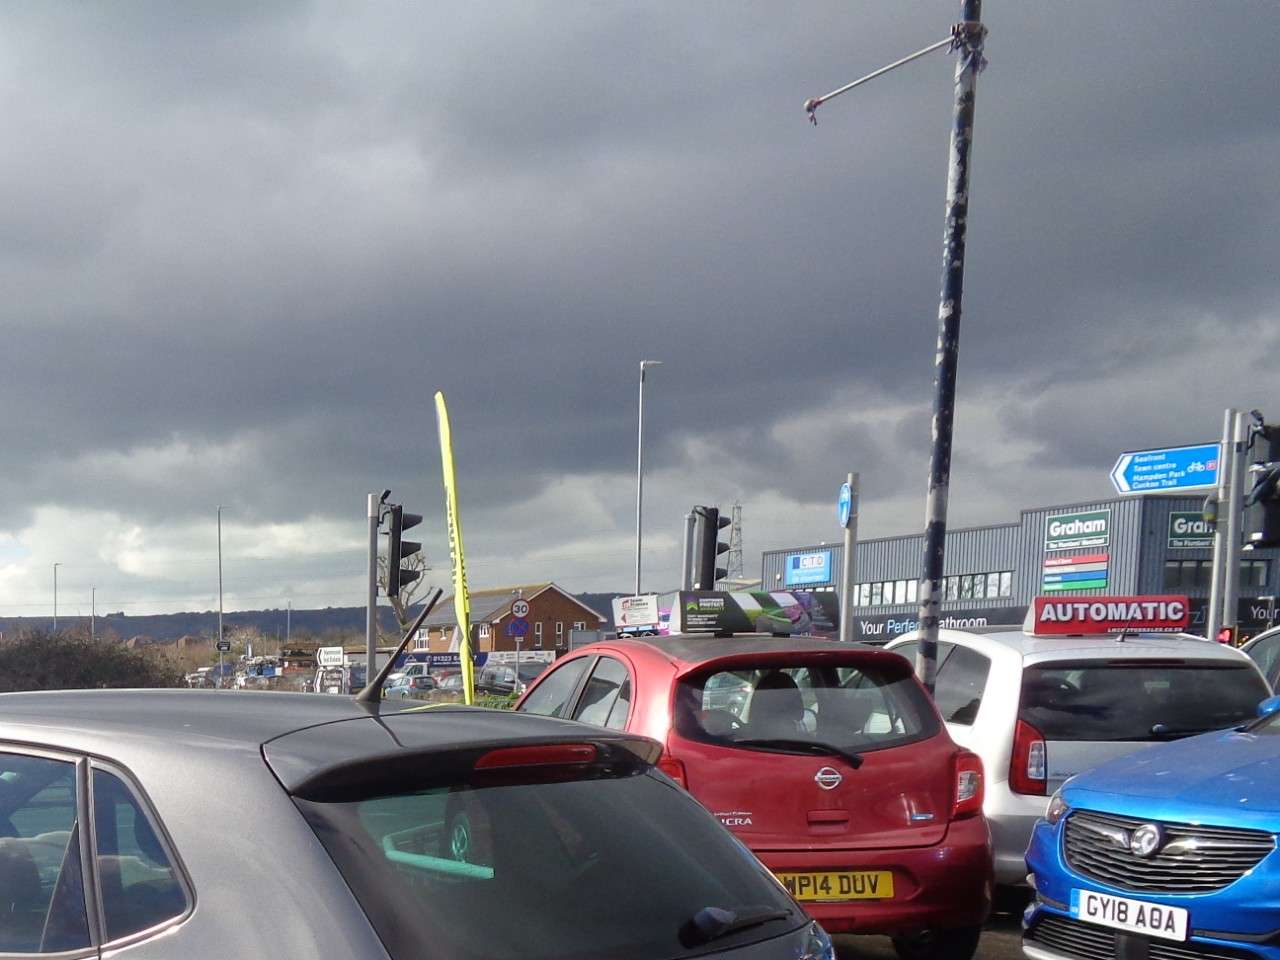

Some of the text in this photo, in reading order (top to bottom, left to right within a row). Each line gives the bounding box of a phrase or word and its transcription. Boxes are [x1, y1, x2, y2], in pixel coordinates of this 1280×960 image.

[1134, 453, 1166, 463] Seafront
[1168, 470, 1185, 478] Park
[1049, 519, 1106, 537] Graham
[514, 604, 528, 614] 30
[1040, 602, 1184, 621] AUTOMATIC
[860, 620, 884, 635] Your
[939, 616, 987, 629] athroom
[721, 817, 752, 826] ICRA
[783, 875, 878, 896] WP14 DUV
[1086, 894, 1129, 923] GY18
